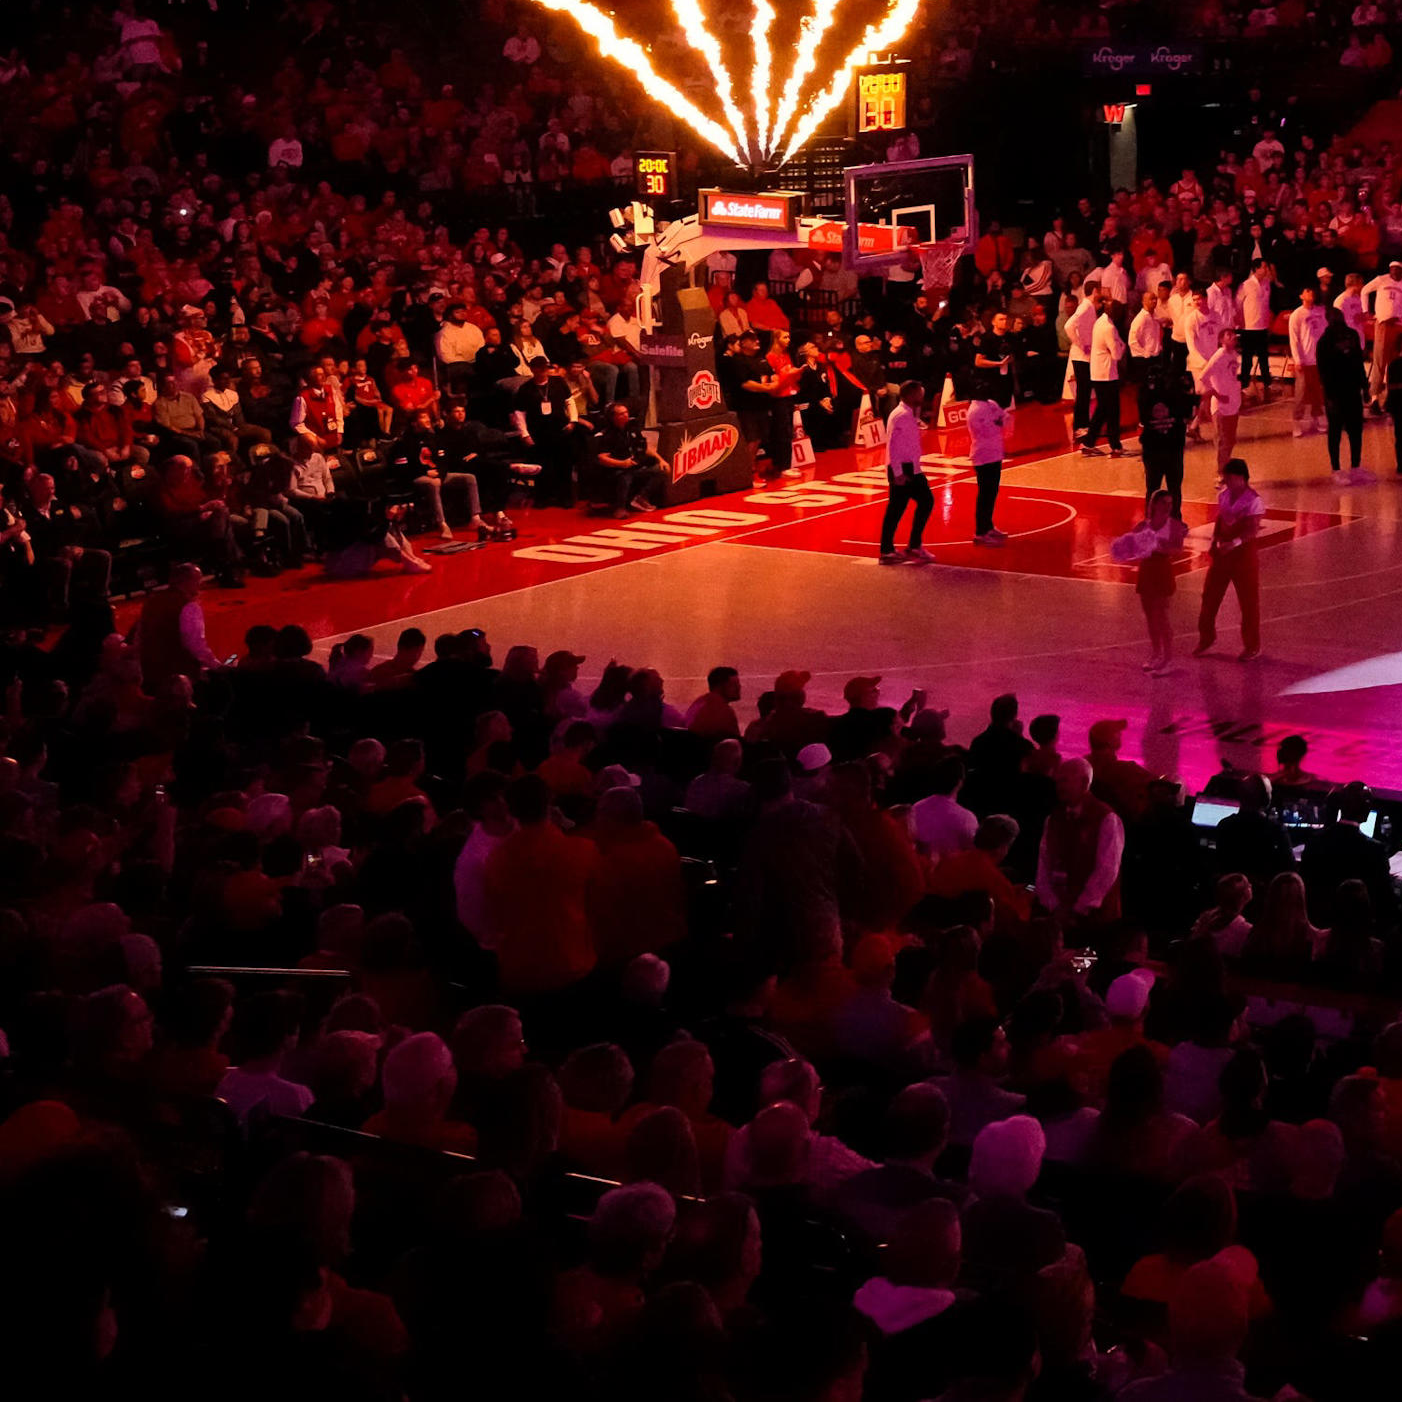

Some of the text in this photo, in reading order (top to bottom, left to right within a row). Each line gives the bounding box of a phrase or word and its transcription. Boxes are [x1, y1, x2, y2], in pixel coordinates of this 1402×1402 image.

[1092, 46, 1193, 71] Kroger Kroger
[647, 174, 665, 194] 30
[673, 429, 733, 485] LIBMAN
